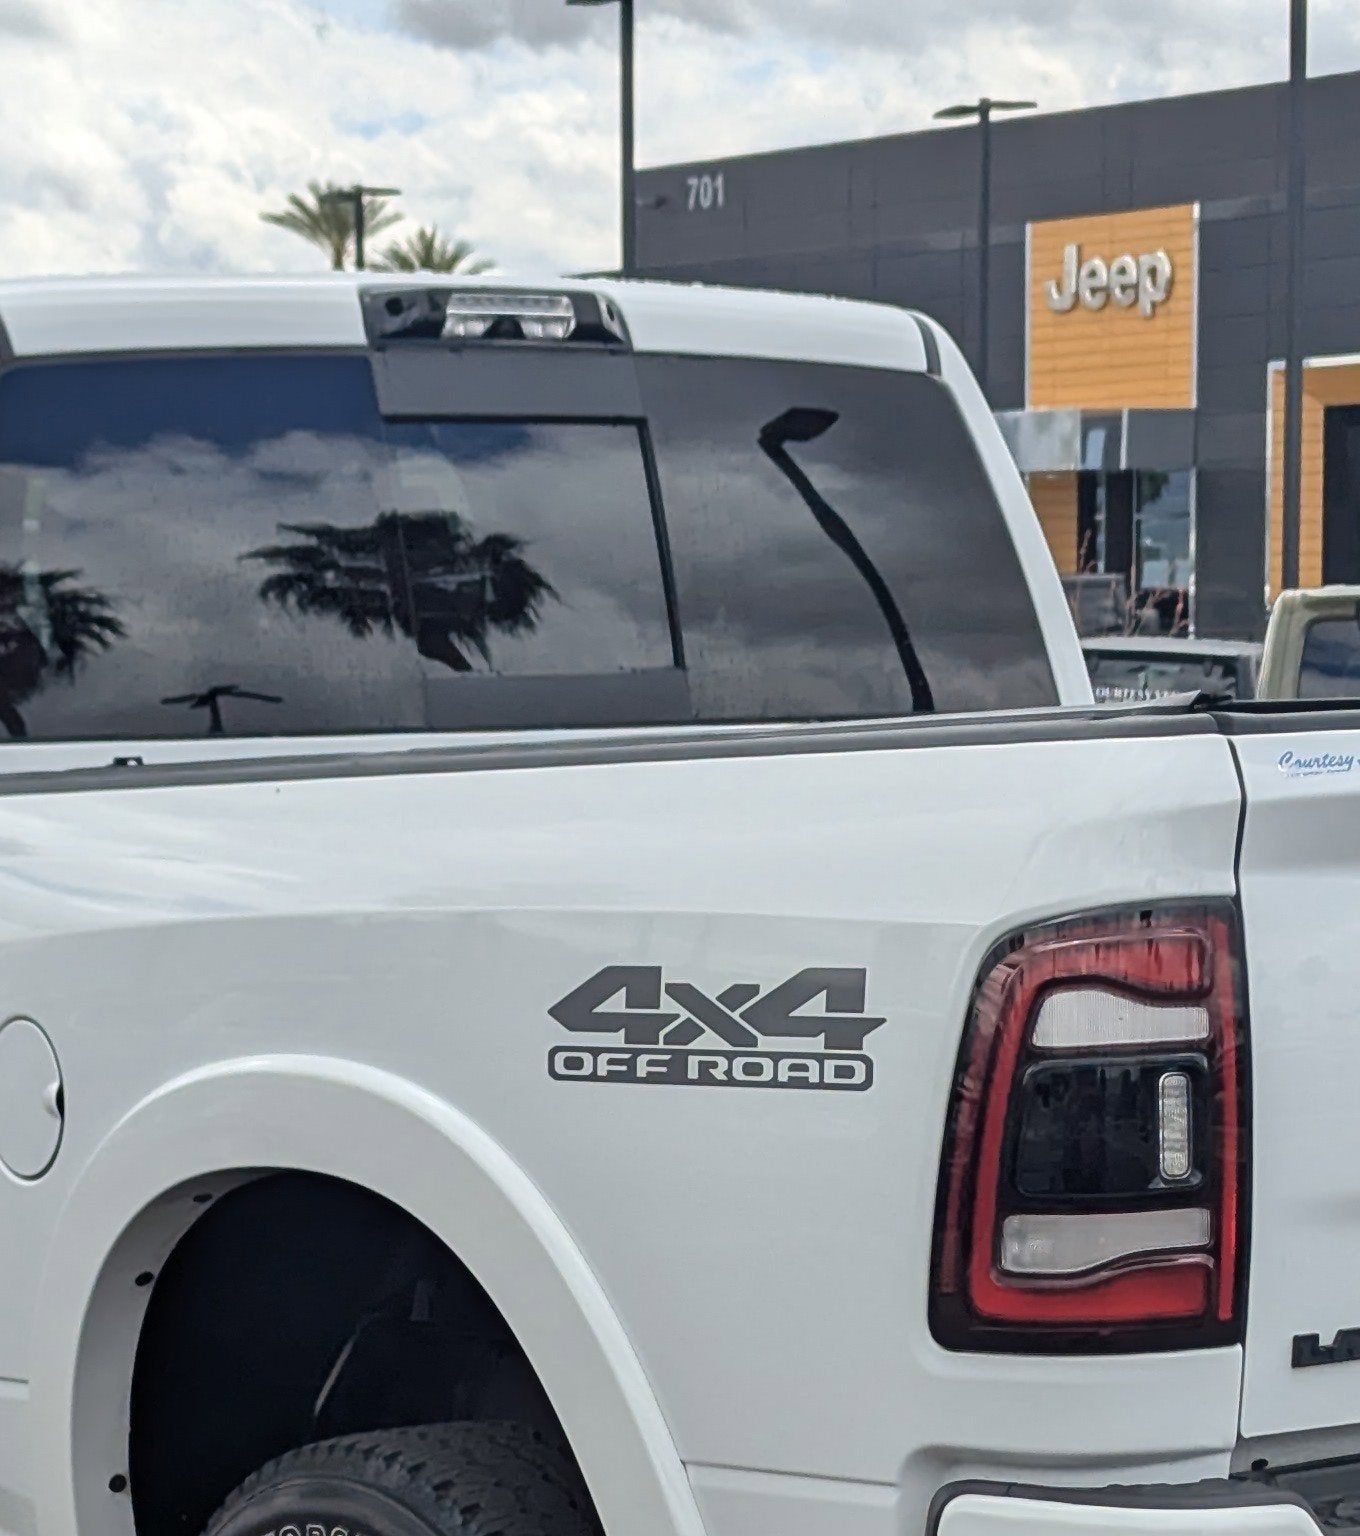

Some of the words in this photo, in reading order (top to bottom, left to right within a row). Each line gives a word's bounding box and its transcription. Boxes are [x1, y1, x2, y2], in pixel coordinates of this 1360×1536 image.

[687, 174, 725, 210] 701
[1044, 243, 1172, 317] Jeep
[553, 1051, 673, 1079] OFF
[686, 1055, 866, 1085] ROAD
